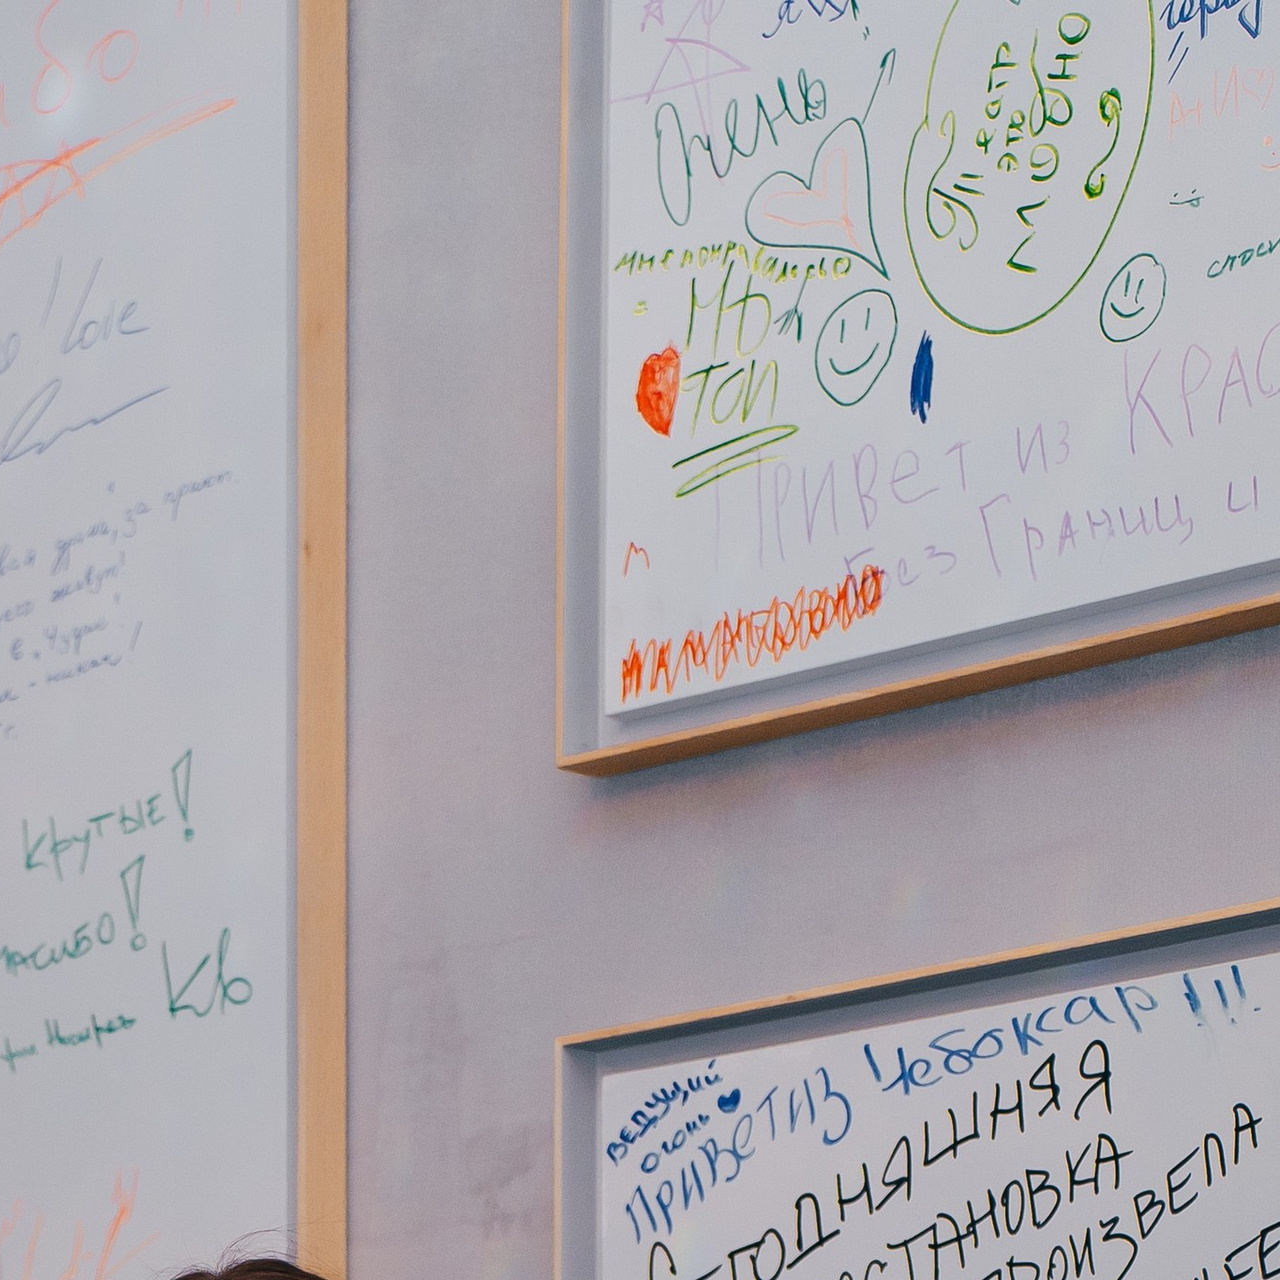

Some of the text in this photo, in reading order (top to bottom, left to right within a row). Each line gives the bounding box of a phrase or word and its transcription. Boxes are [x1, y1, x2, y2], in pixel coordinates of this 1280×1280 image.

[995, 109, 1027, 173] это
[1017, 420, 1071, 474] ИЗ
[625, 1085, 779, 1245] ПРИВЕТ
